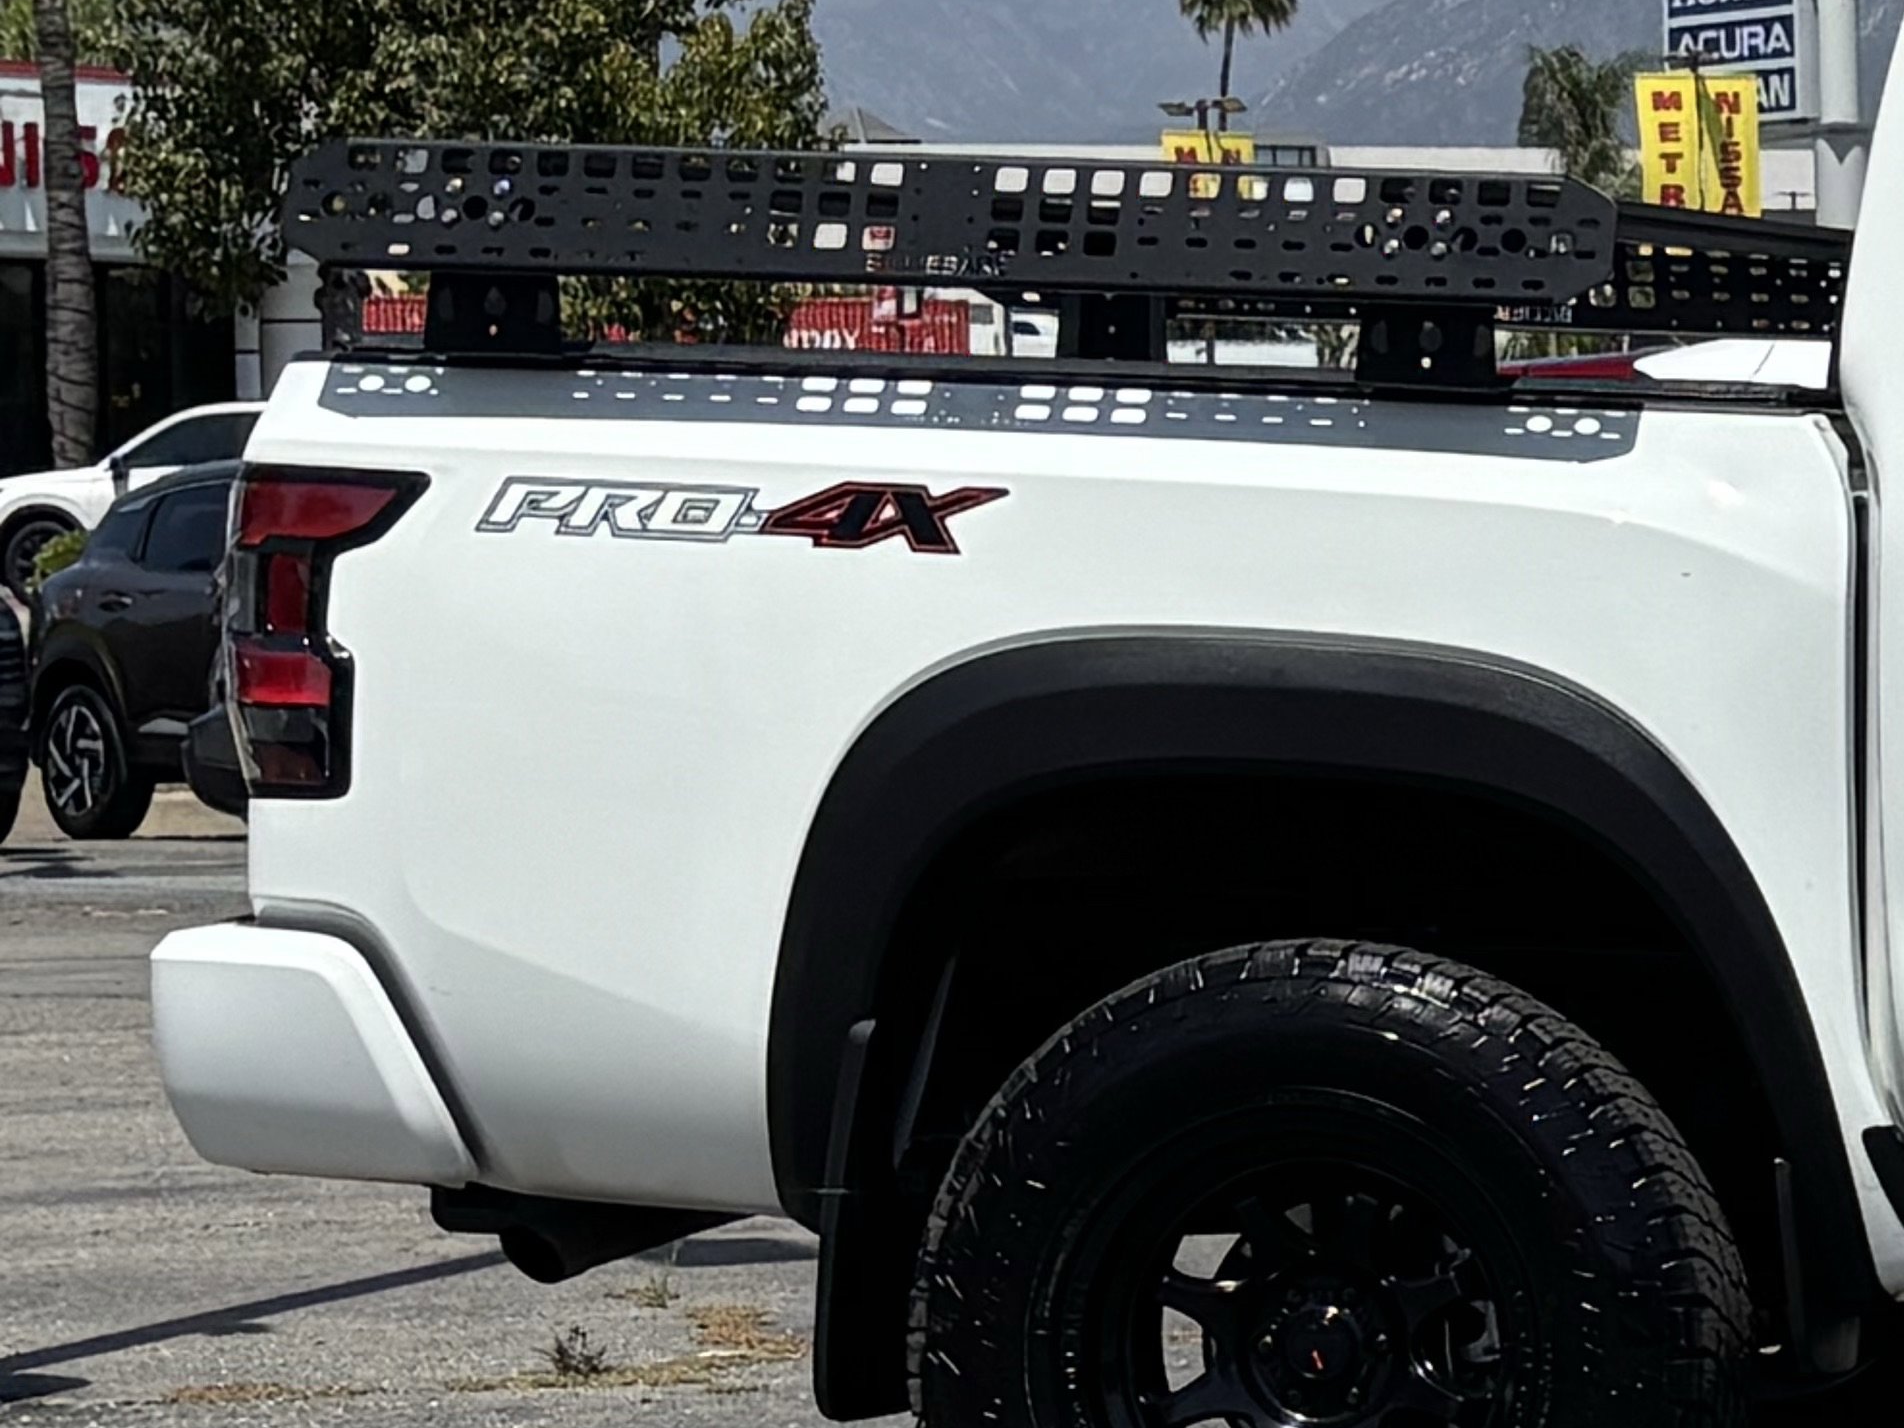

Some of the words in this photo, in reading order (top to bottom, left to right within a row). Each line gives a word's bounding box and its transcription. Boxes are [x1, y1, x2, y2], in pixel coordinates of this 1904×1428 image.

[1678, 21, 1791, 60] ACURA
[1652, 91, 1685, 208] METR
[1714, 91, 1744, 215] NISSA
